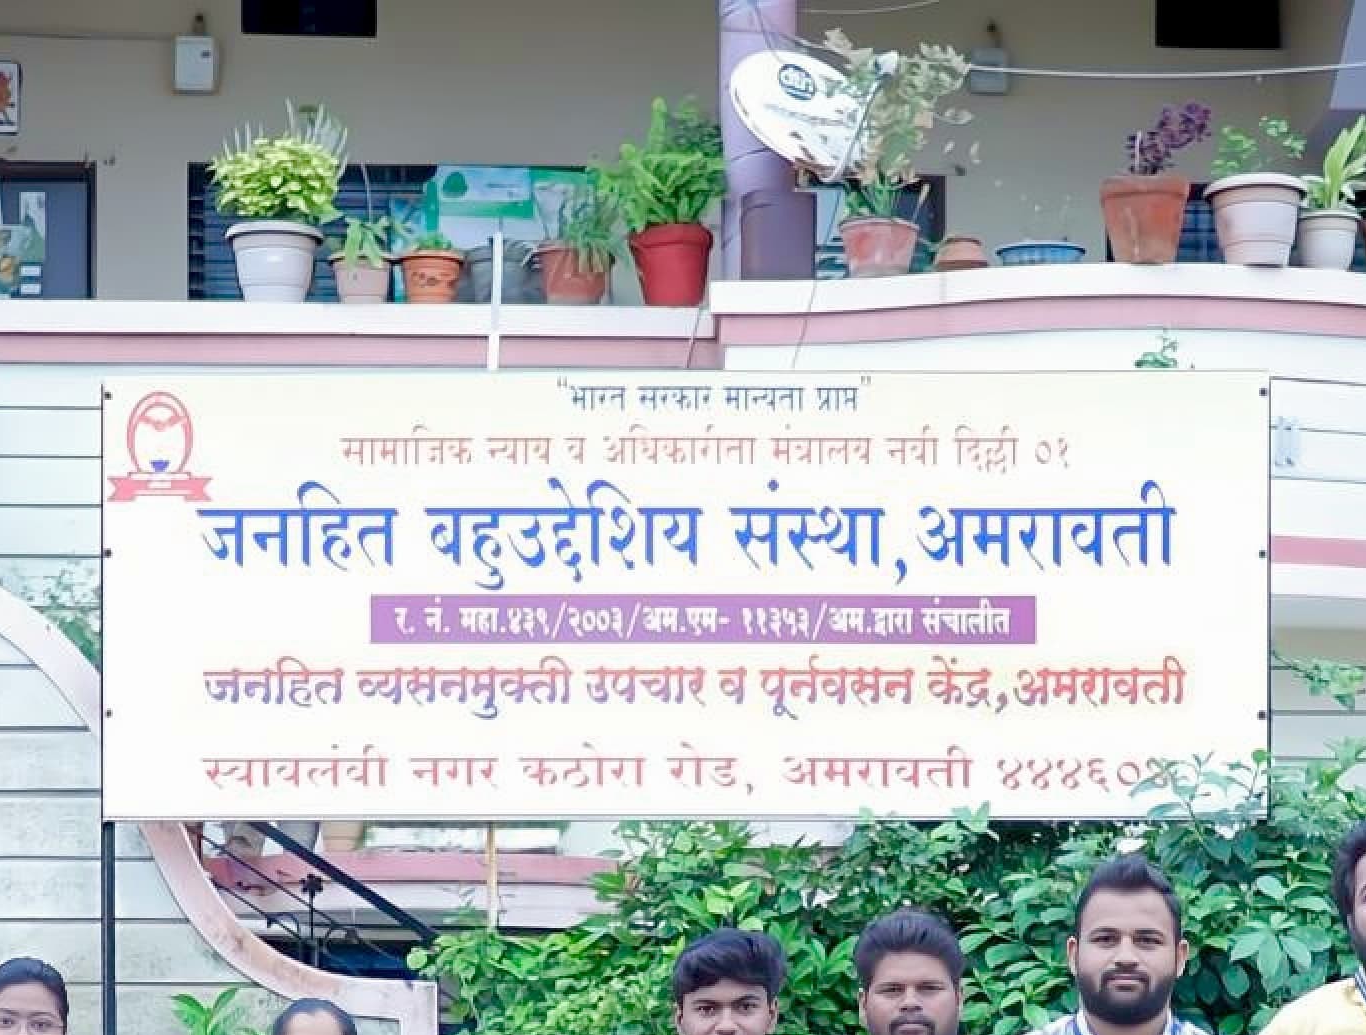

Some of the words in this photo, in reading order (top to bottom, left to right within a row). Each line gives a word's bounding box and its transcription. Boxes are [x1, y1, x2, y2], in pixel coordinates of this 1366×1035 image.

[635, 384, 713, 412] सरकार
[721, 384, 805, 412] मान्यता
[339, 423, 475, 466] सामाजिक
[485, 434, 553, 466] न्याय
[564, 434, 587, 466] व
[769, 422, 873, 466] मंत्रालय
[884, 424, 940, 466] नवी
[952, 424, 1021, 474] दिल्ली
[196, 480, 398, 570] जनहित
[201, 655, 345, 708] जनहित
[355, 654, 575, 720] व्यसनमुक्ती
[584, 664, 707, 708] उपचार
[717, 664, 748, 706] व
[201, 742, 391, 790] स्वावलंबी
[409, 754, 499, 790] नगर
[781, 743, 975, 790] अमरावती
